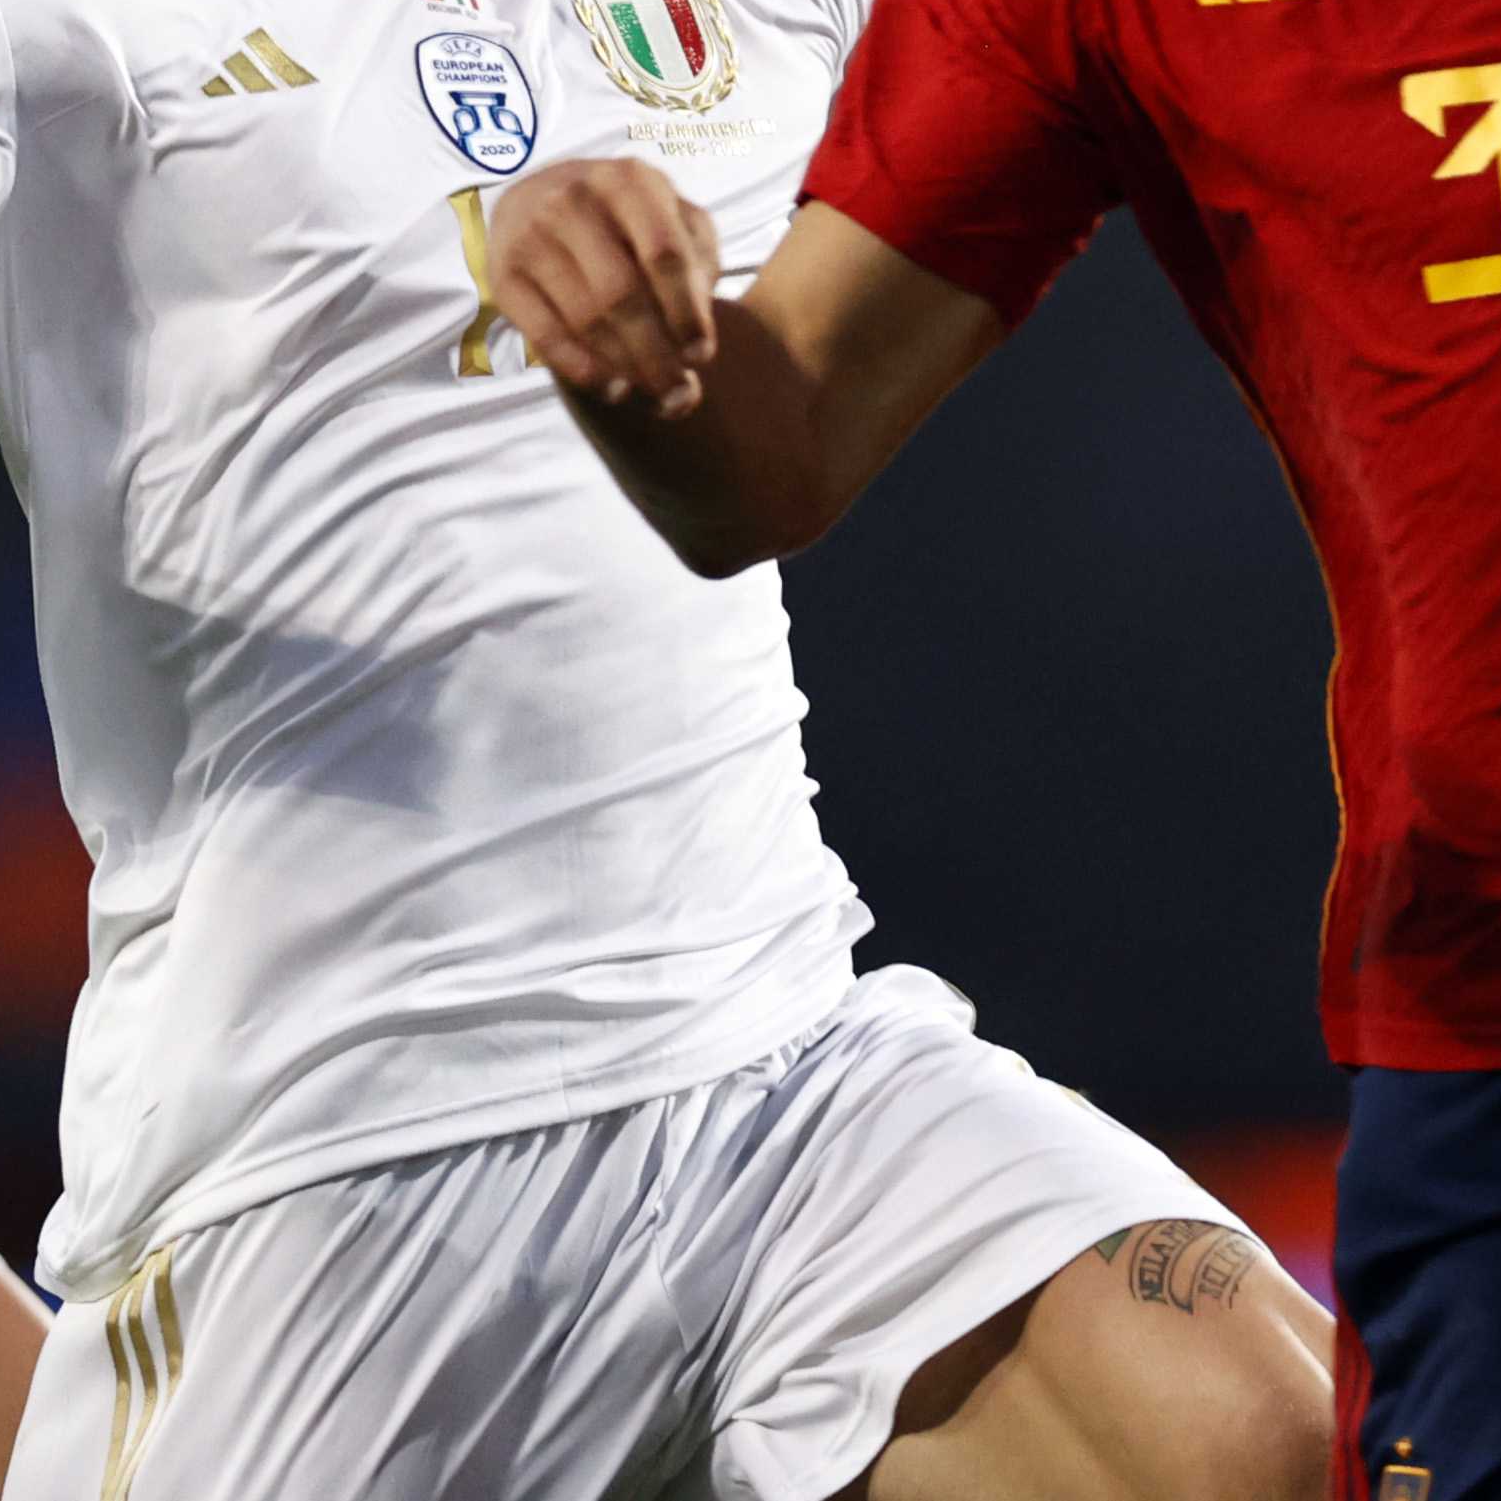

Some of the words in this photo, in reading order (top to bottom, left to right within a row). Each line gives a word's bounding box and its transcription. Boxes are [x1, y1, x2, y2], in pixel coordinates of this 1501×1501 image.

[442, 39, 482, 55] UEFA
[432, 59, 505, 73] EUROPEAN
[436, 72, 508, 84] CHAMPIONS
[478, 143, 517, 156] 2020
